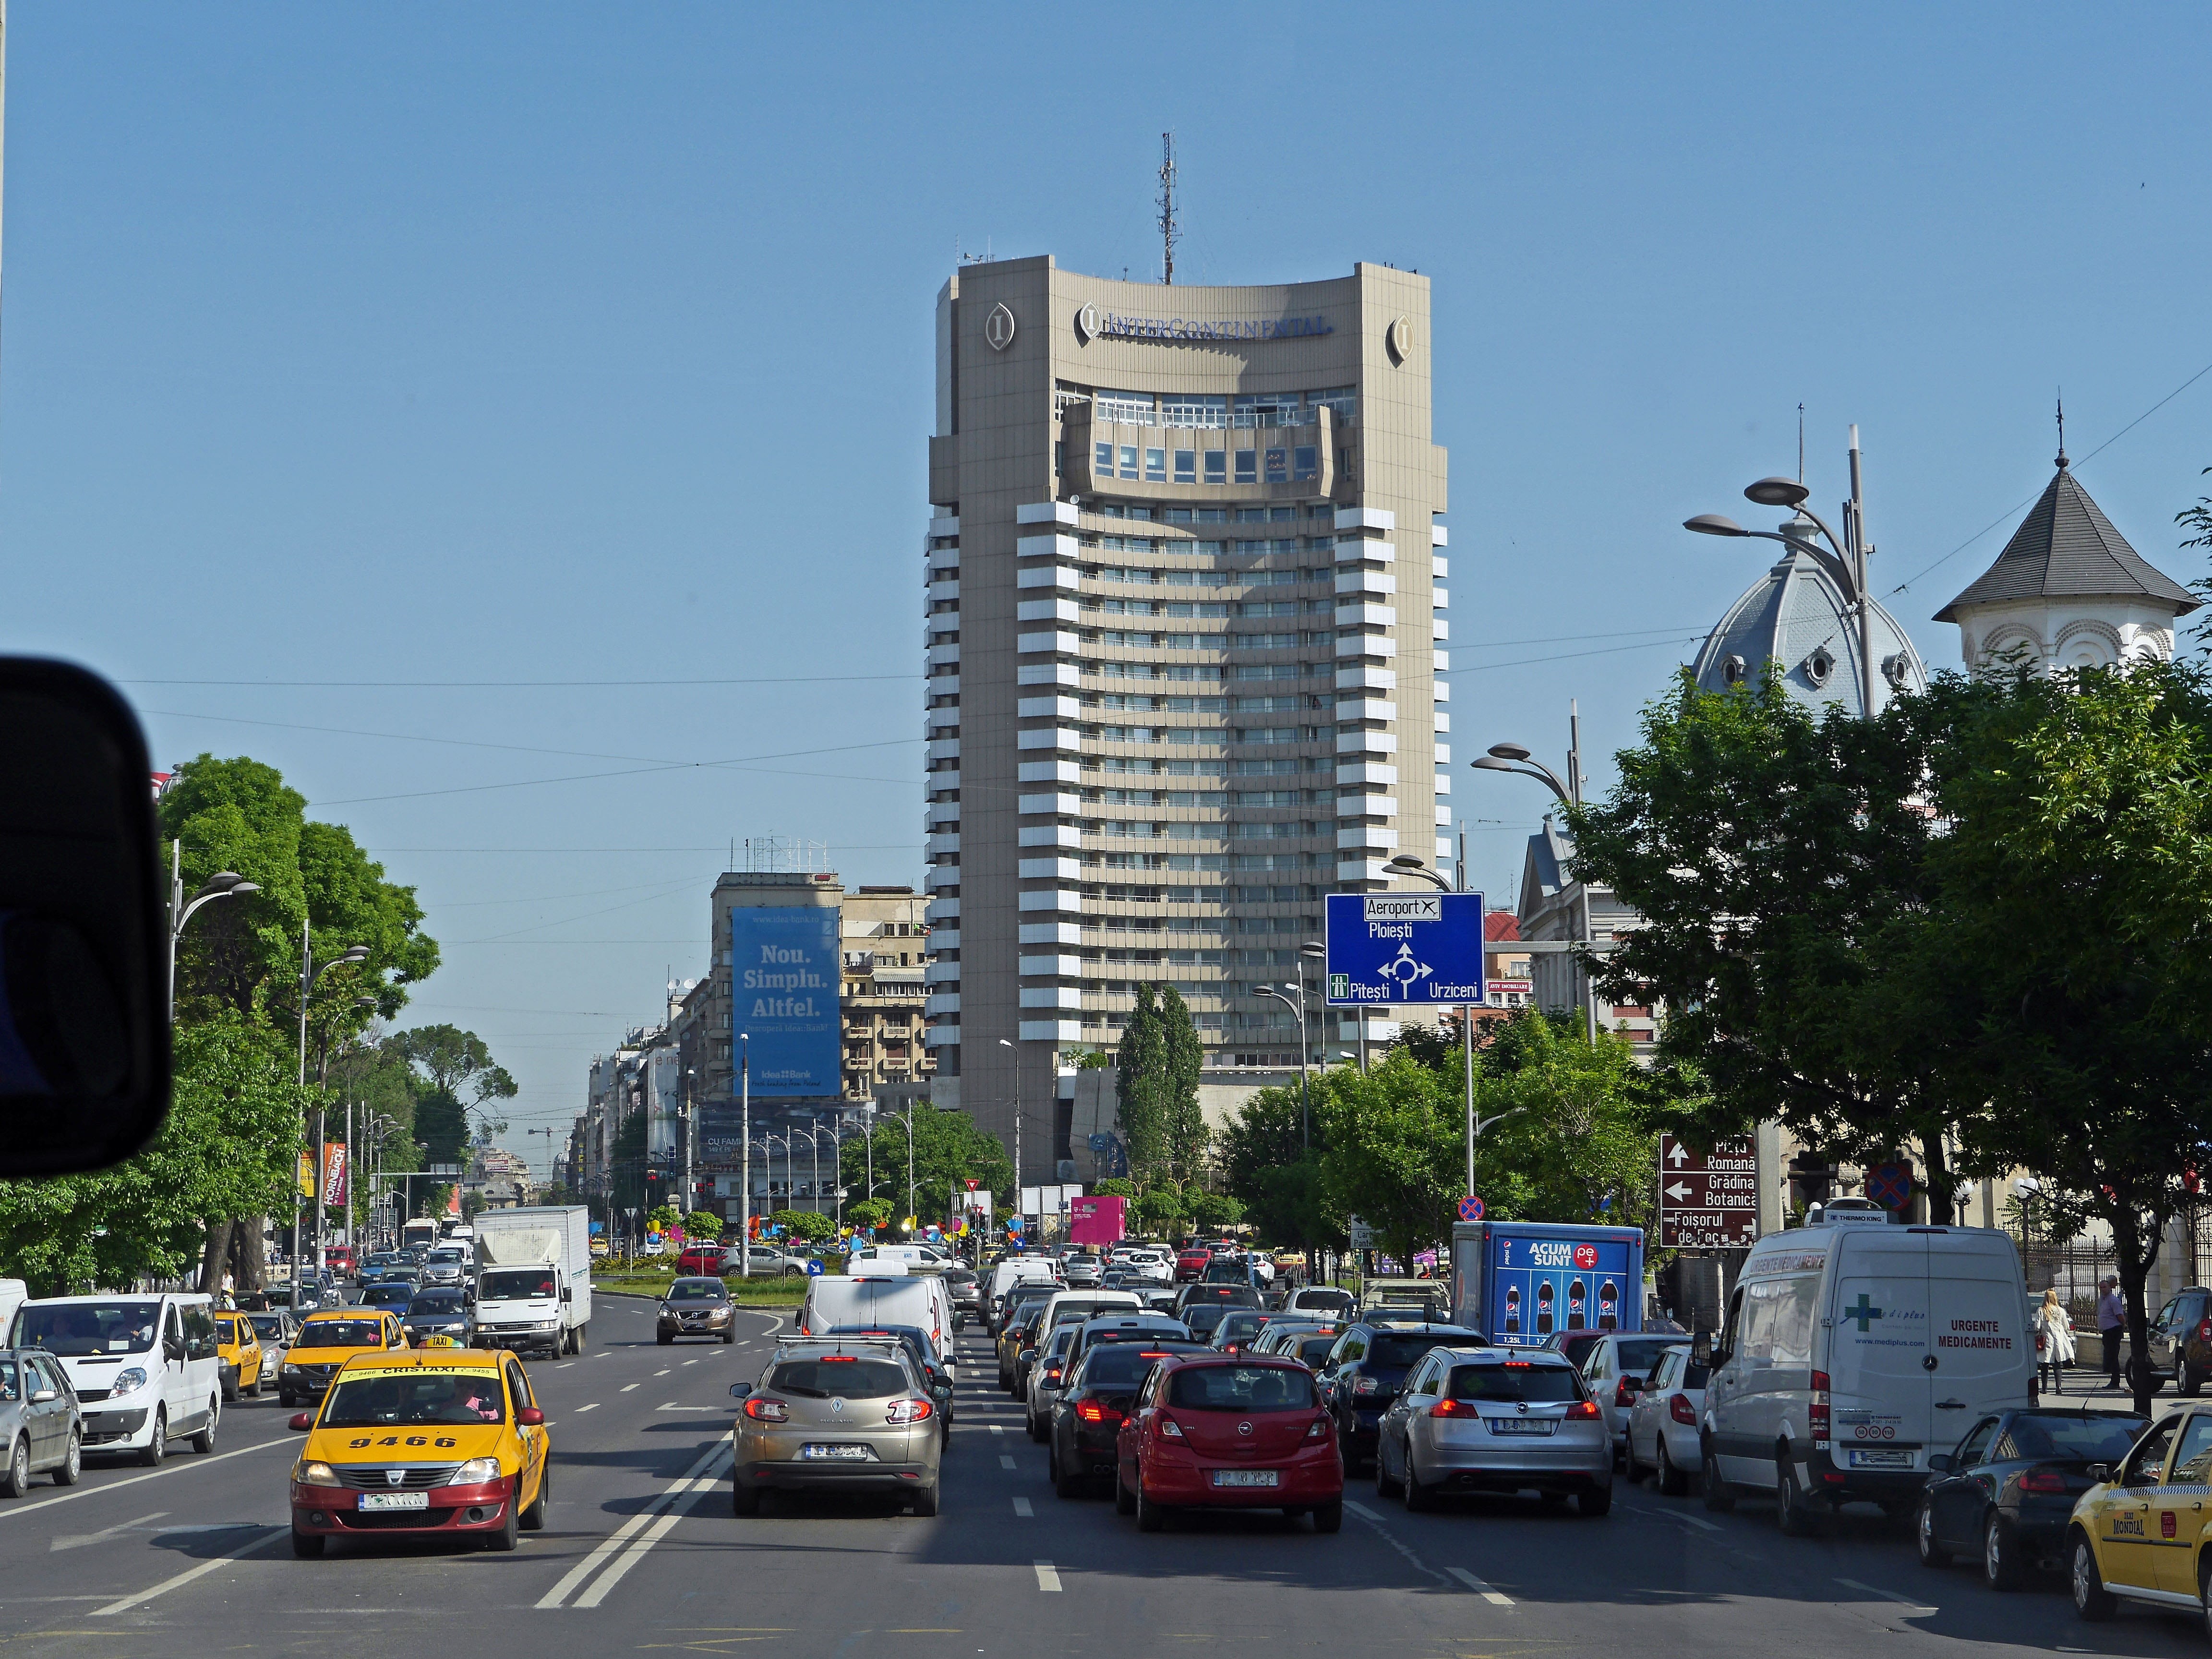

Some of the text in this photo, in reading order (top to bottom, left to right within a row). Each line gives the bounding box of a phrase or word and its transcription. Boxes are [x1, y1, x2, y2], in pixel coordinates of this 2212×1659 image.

[1367, 899, 1419, 918] Aeroport
[1369, 922, 1412, 941] Ploiești
[760, 945, 811, 963] Nou.
[744, 968, 828, 993] Simplu.
[1350, 982, 1390, 1002] Pitești
[1430, 982, 1478, 998] Urziceni
[751, 997, 821, 1017] Altfel.
[762, 1070, 811, 1079] Idea Bank
[1707, 1155, 1755, 1170] Romană
[324, 1149, 345, 1205] HORNBACH
[1708, 1174, 1755, 1190] Grădina
[1705, 1191, 1756, 1206] Botanică
[1674, 1212, 1723, 1229] Foișorul
[1678, 1229, 1693, 1243] de
[1529, 1242, 1572, 1255] ACUM
[1577, 1247, 1595, 1259] pe
[1534, 1254, 1572, 1267] SUNT
[432, 1337, 447, 1346] TAXI
[1855, 1338, 1925, 1347] www.mediplus.com
[1938, 1336, 2011, 1350] MEDICAMENTE
[349, 1436, 457, 1448] 9466
[2113, 1519, 2144, 1536] MONDIAL
